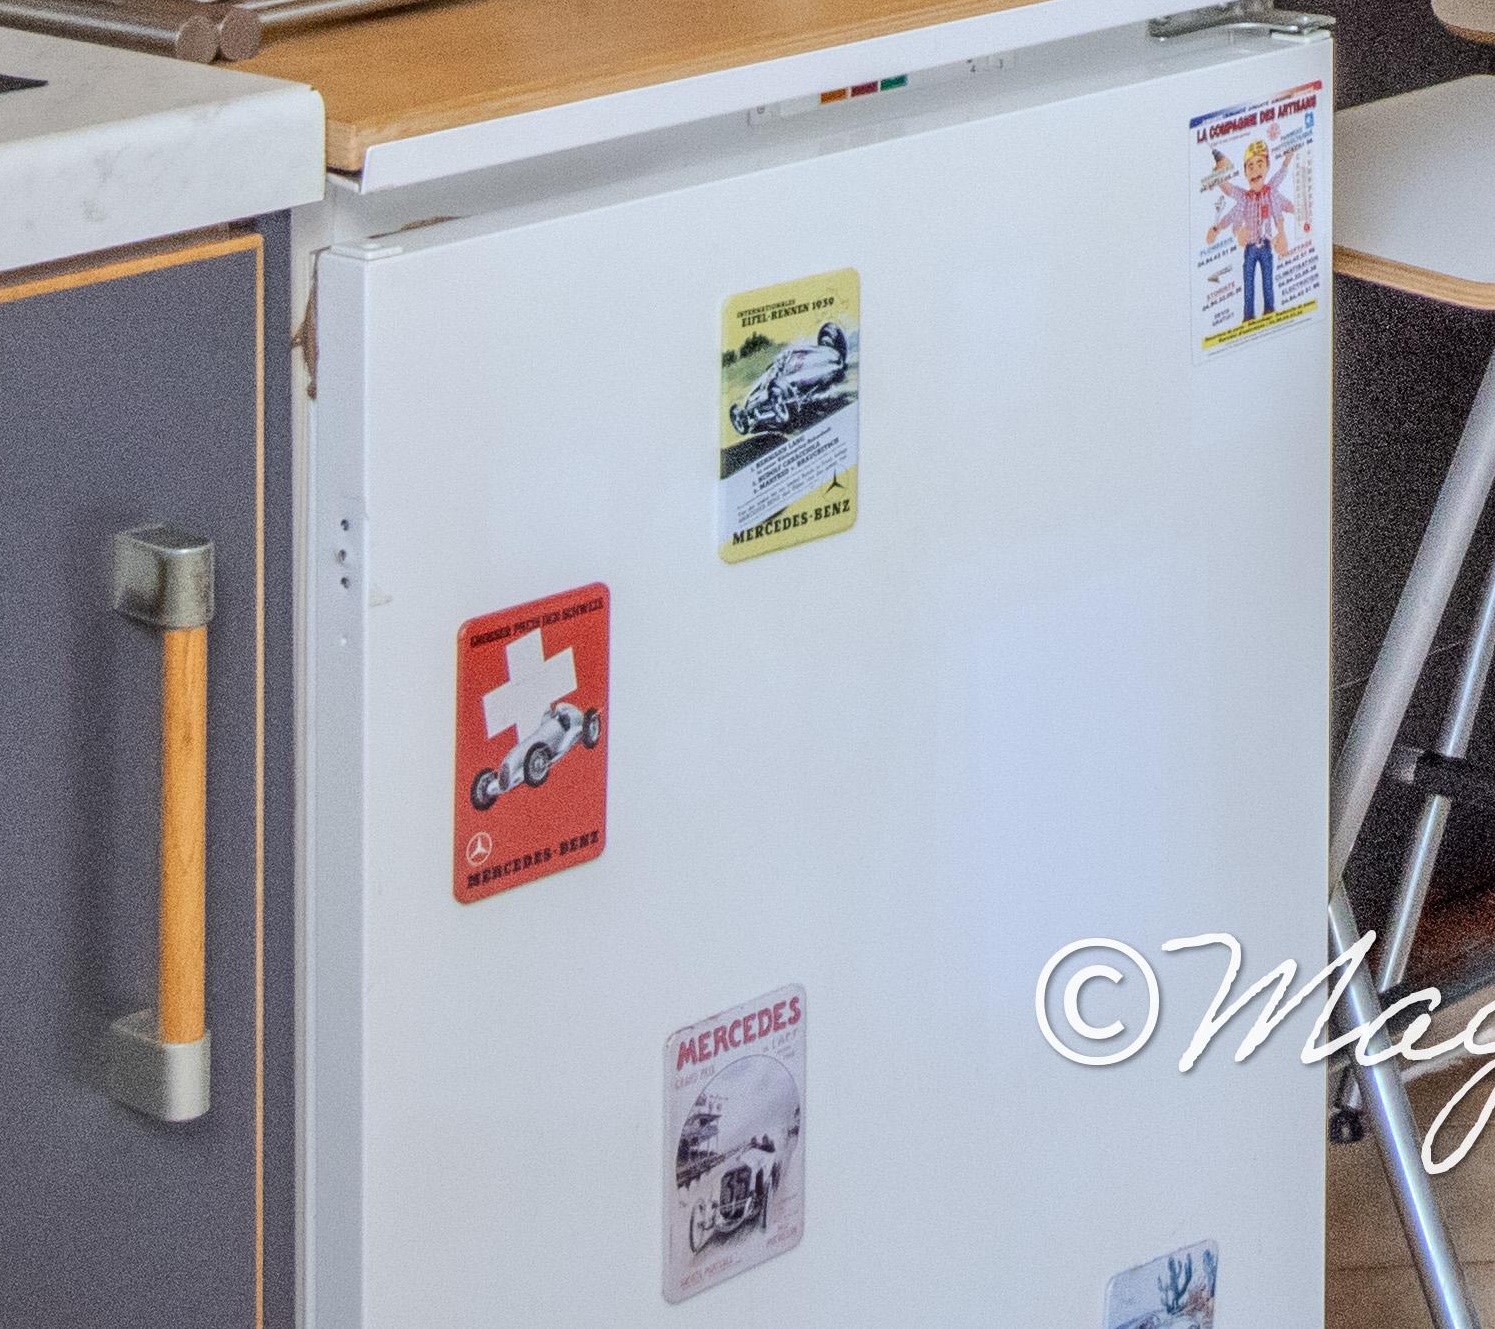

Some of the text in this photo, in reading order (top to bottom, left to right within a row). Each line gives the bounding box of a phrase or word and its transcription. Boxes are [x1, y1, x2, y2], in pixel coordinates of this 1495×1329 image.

[1196, 128, 1208, 144] LA
[1259, 107, 1276, 124] DES
[676, 995, 802, 1072] MERCEDES
